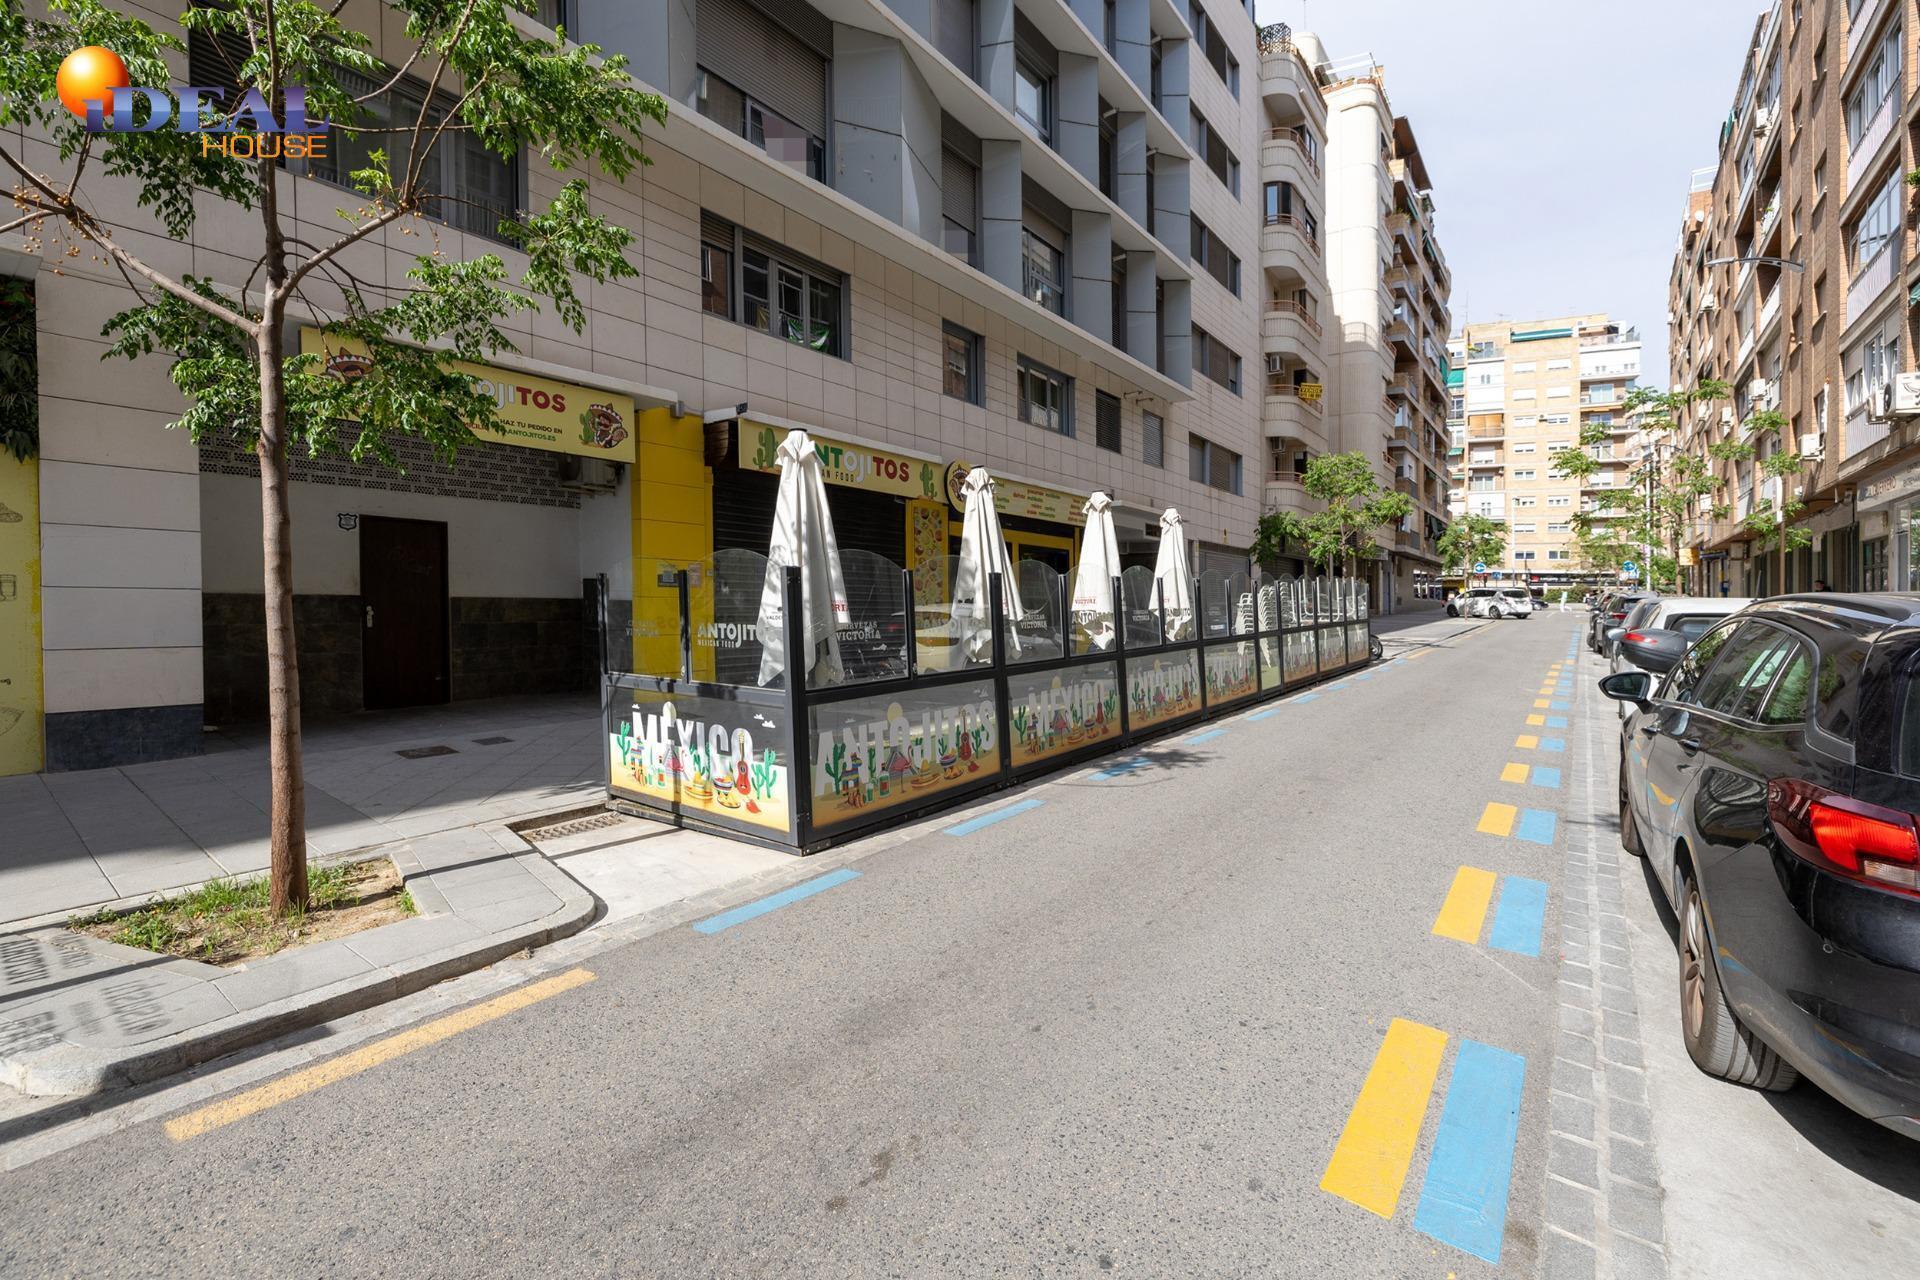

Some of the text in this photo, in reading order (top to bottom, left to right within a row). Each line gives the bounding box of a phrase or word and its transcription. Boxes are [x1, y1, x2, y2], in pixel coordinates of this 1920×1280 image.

[476, 379, 567, 413] OJITOS
[500, 418, 563, 435] HAZ TU PEDIDO EN
[815, 443, 910, 483] NTOJITOS
[835, 471, 854, 483] FOOD
[1020, 620, 1048, 630] VICTORIA
[697, 622, 757, 649] ANTOJIT
[697, 639, 735, 649] MEXICAN FOOD
[836, 630, 882, 642] VICTORIA
[813, 699, 997, 798] ANTOJITOS
